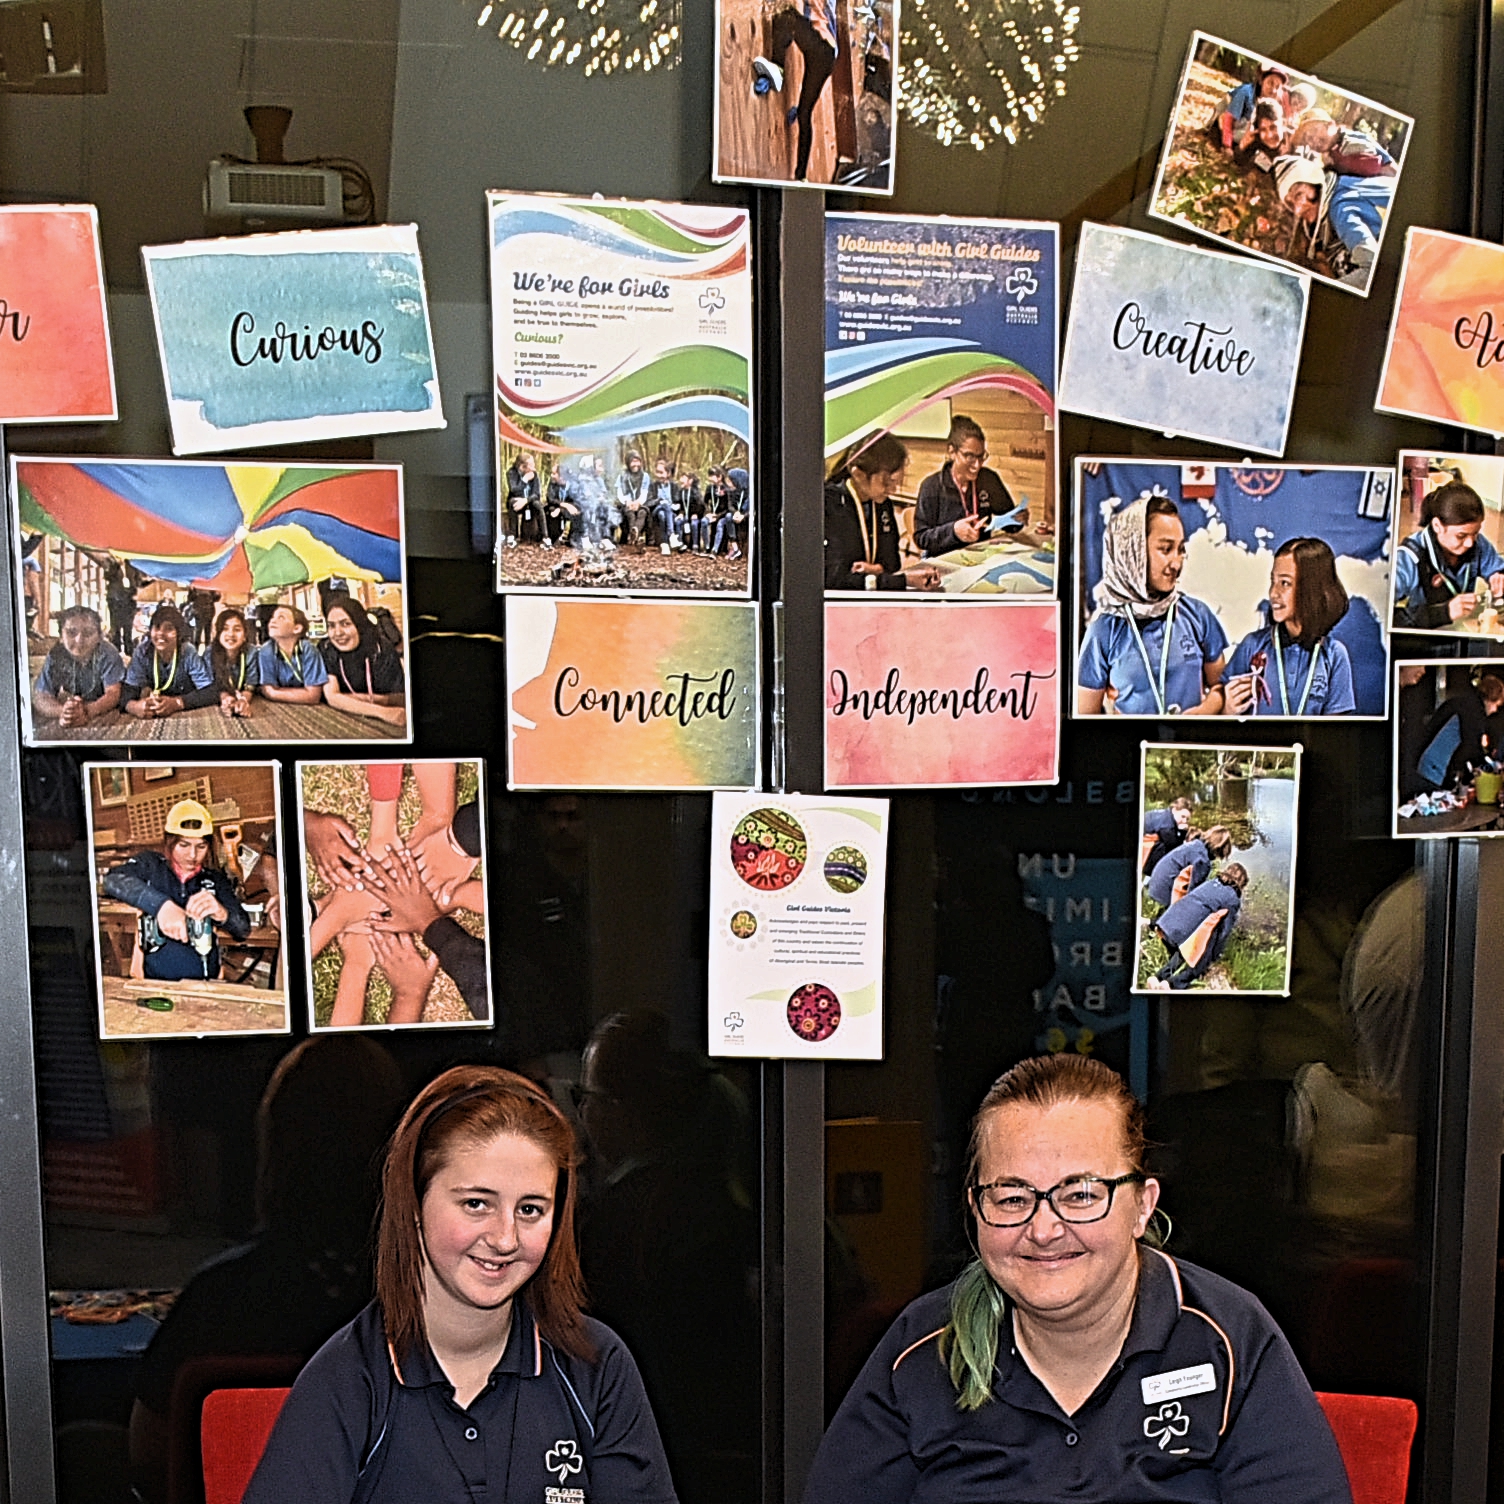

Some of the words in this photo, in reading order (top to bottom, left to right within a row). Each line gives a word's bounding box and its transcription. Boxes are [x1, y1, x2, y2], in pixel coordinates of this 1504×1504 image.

[837, 234, 915, 253] Volunteer
[916, 240, 953, 257] with
[954, 241, 989, 259] Girl
[990, 243, 1041, 262] Guides
[512, 271, 575, 294] We're
[578, 275, 615, 299] for
[618, 277, 671, 299] Girls
[230, 310, 385, 368] Curious
[514, 331, 564, 345] Curious?
[1112, 301, 1256, 377] Creative
[554, 666, 737, 726] Connected
[829, 667, 1056, 726] Independent
